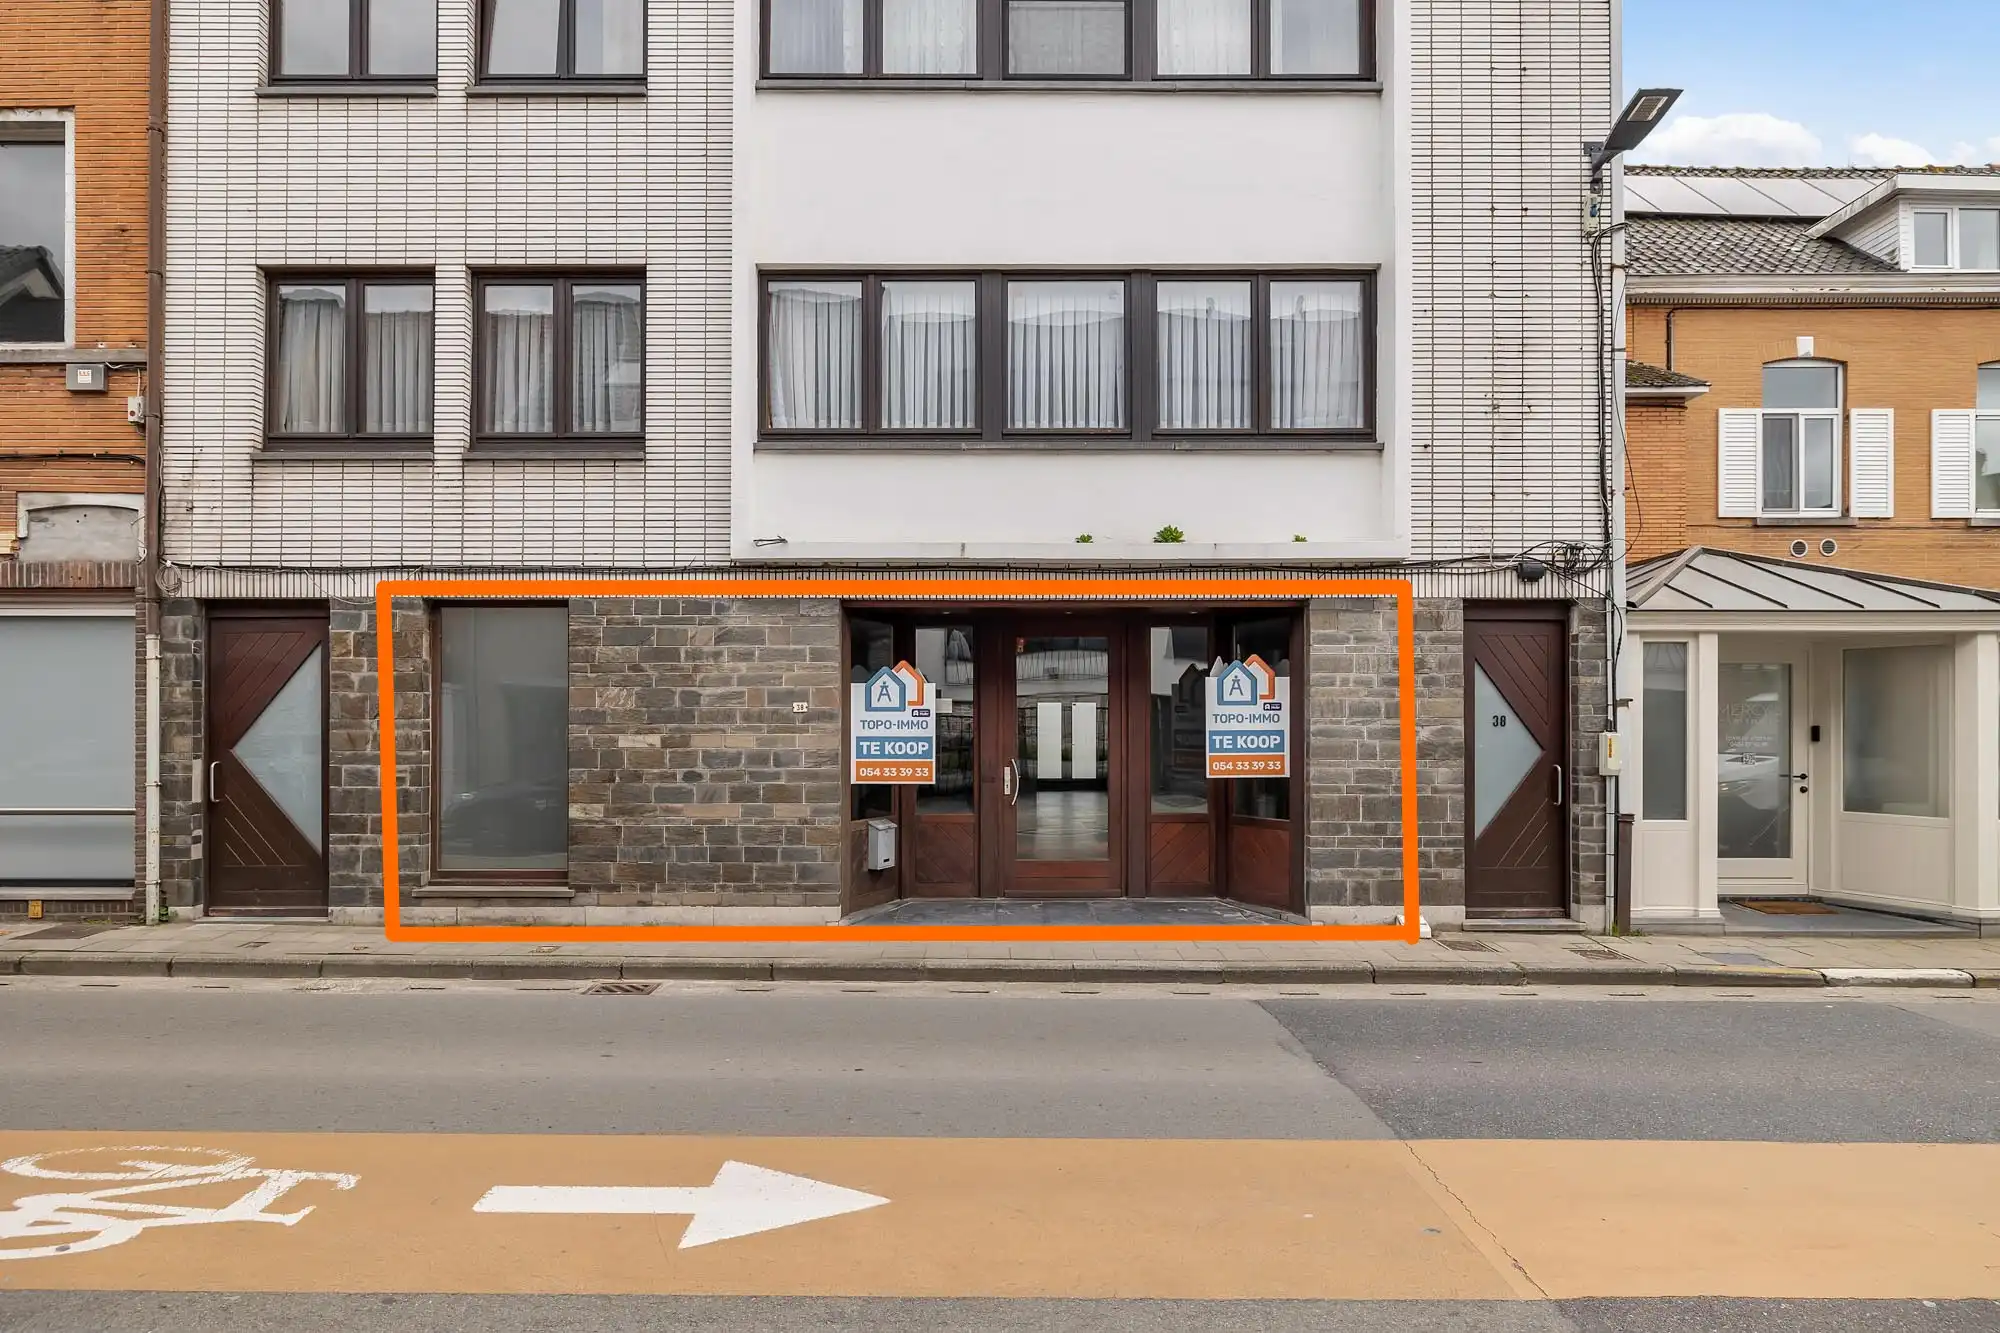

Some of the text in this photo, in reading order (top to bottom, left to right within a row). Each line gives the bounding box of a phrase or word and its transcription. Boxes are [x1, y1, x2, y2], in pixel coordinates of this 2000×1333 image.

[1212, 713, 1281, 724] TOPO-IMMO
[1492, 715, 1507, 727] 38
[860, 719, 929, 730] TOPO-IMMO
[1212, 735, 1281, 749] TE KOOP
[859, 741, 929, 755] TE KOOP
[1212, 761, 1281, 771] 054 33 39 33
[859, 767, 929, 777] 054 33 39 33
